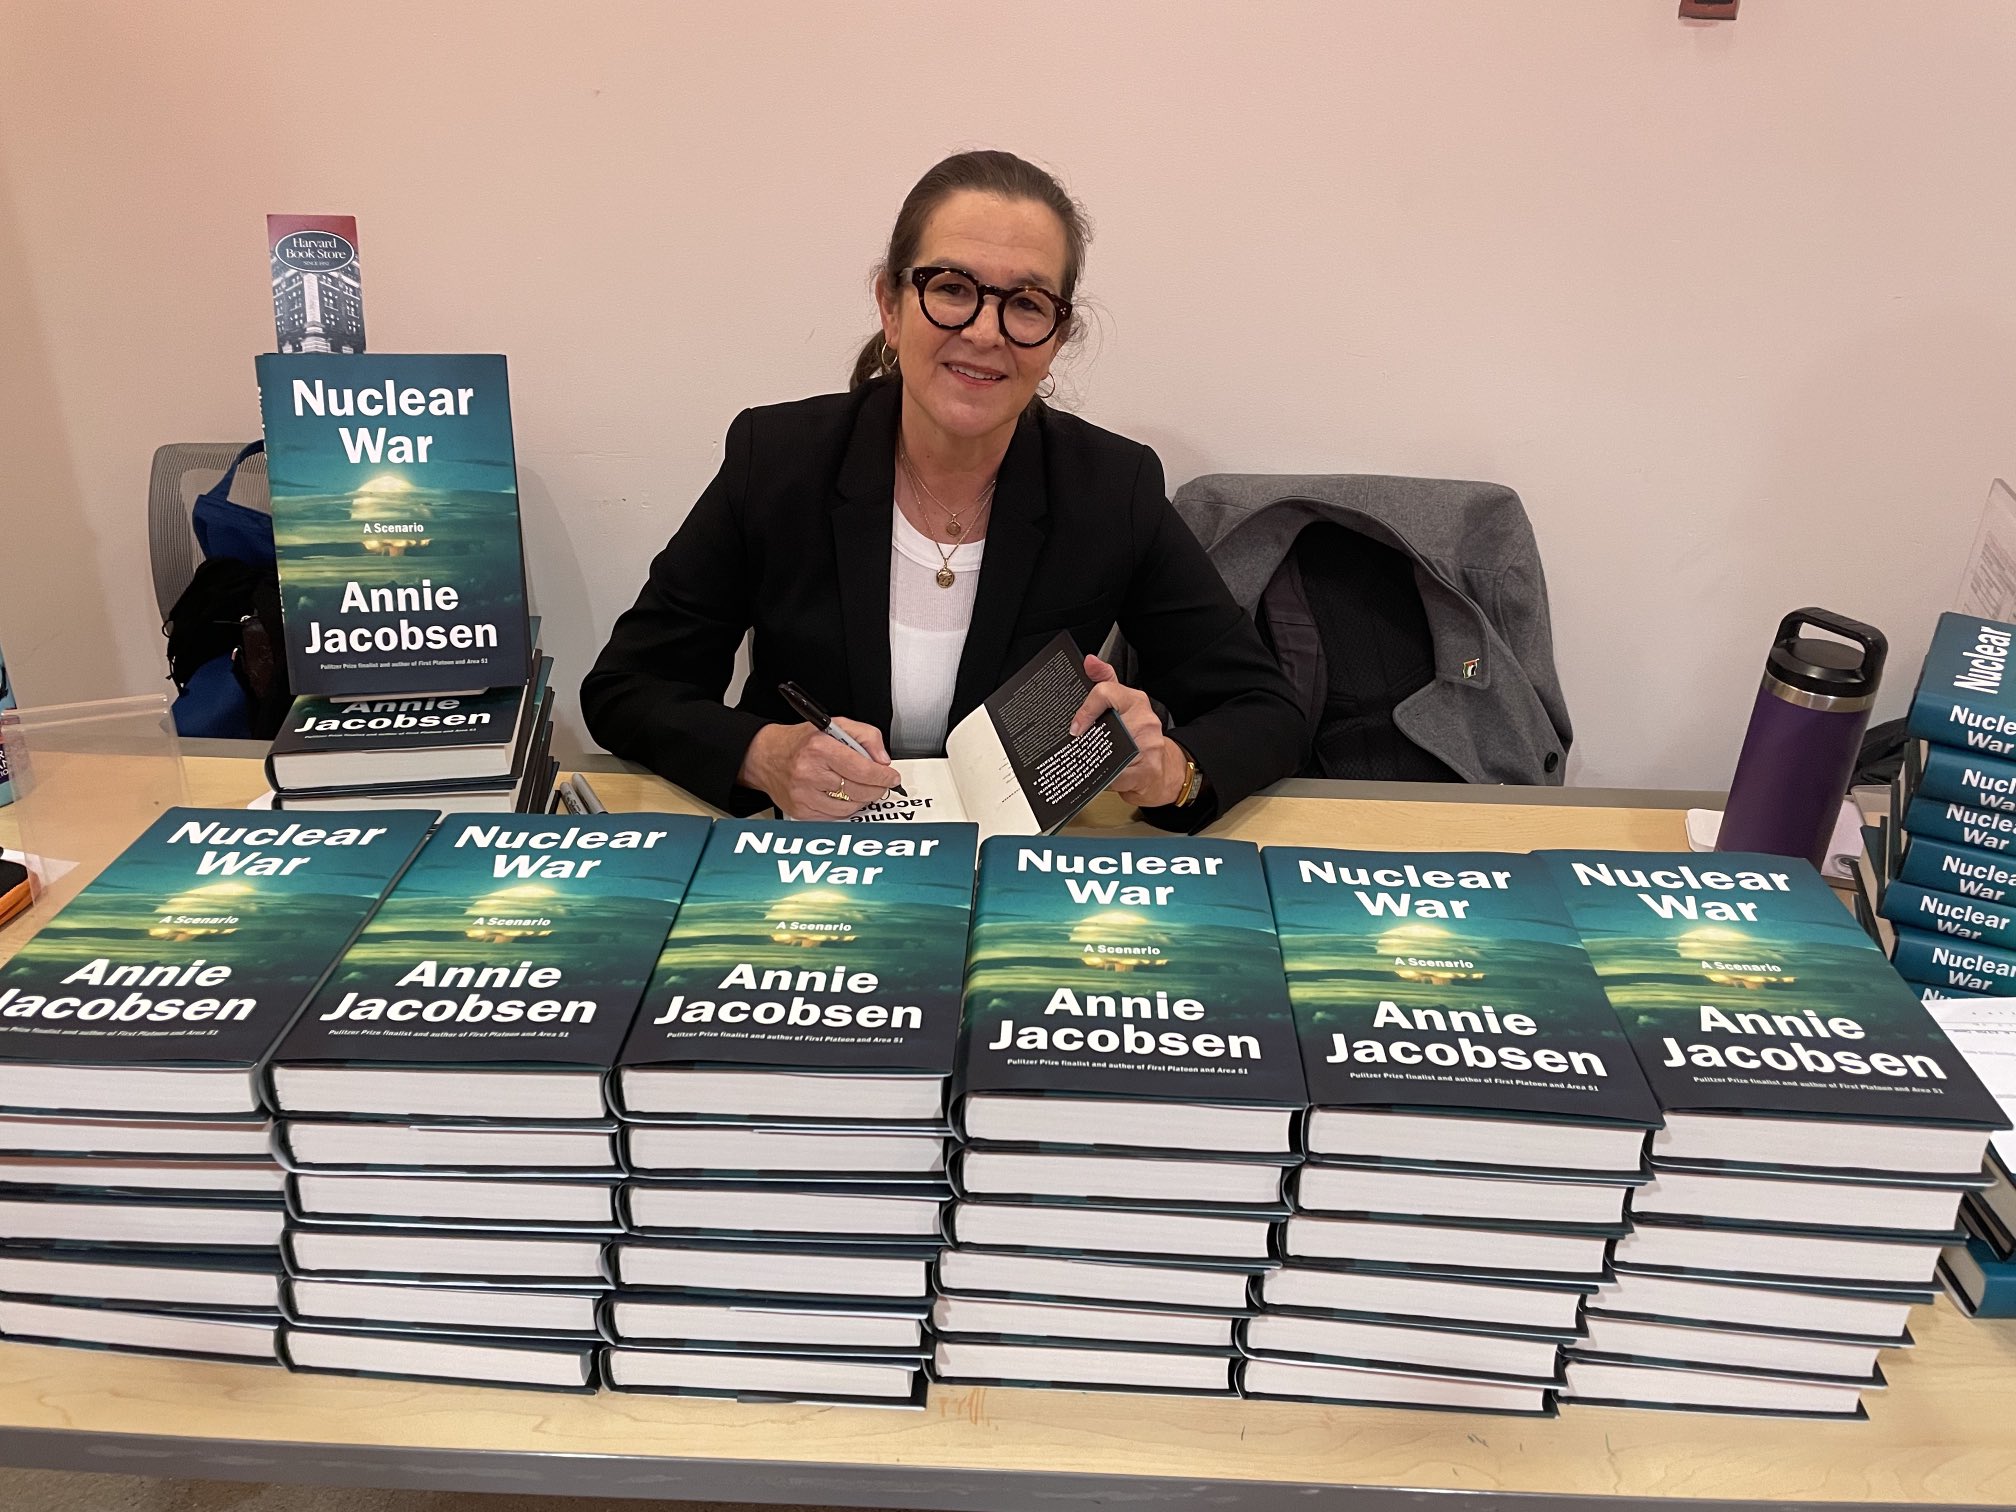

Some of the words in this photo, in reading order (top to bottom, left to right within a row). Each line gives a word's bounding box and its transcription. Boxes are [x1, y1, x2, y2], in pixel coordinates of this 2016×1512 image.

[285, 248, 315, 259] Book
[317, 249, 347, 259] Store
[293, 238, 336, 248] Harvard
[292, 379, 474, 417] Nuclear
[338, 427, 433, 464] War
[363, 523, 372, 534] A
[374, 522, 424, 534] Scenario
[340, 579, 459, 614] Annie
[305, 619, 498, 654] Jacobsen
[1953, 626, 2011, 694] Nuclear
[342, 698, 460, 713] Annie
[294, 712, 491, 732] Jacobsen
[1967, 730, 2015, 754] War
[1962, 769, 2016, 795] Nucl
[1946, 804, 2016, 834] Nucle
[167, 821, 387, 846] Nuclear
[454, 826, 667, 849] Nuclear
[733, 832, 939, 857] Nuclear
[1963, 827, 2009, 850] War
[195, 851, 310, 876] War
[492, 855, 601, 878] War
[777, 860, 883, 885] War
[1017, 849, 1223, 875] Nuclear
[1299, 860, 1512, 890] Nuclear
[1572, 863, 1790, 892] Nuclear
[1065, 879, 1174, 905] War
[1960, 879, 2005, 901] War
[1354, 891, 1470, 919] War
[1638, 894, 1757, 922] War
[1920, 895, 2010, 930] Nuclear
[159, 915, 171, 924] A
[173, 915, 239, 924] Scenario
[473, 917, 484, 926] A
[487, 917, 551, 927] Scenario
[776, 921, 786, 930] A
[790, 921, 851, 932] Scenario
[1937, 919, 1982, 940] War
[1084, 944, 1094, 953] A
[1097, 944, 1160, 955] Scenario
[61, 959, 232, 987] Annie
[395, 961, 562, 988] Annie
[1395, 957, 1404, 966] A
[1407, 958, 1474, 969] Scenario
[1701, 961, 1710, 970] A
[1713, 961, 1782, 973] Scenario
[717, 964, 879, 994] Annie
[1948, 970, 1993, 990] War
[320, 993, 597, 1024] Jacobsen
[653, 996, 922, 1029] Jacobsen
[1044, 988, 1205, 1021] Annie
[1373, 1000, 1538, 1036] Annie
[1700, 1005, 1866, 1040] Annie
[383, 1029, 413, 1037] finalist
[537, 1030, 557, 1038] Area
[720, 1031, 749, 1039] finalist
[795, 1034, 804, 1042] of
[893, 1036, 904, 1044] 51
[989, 1020, 1262, 1059] Jacobsen
[1040, 1058, 1060, 1066] Prize
[1061, 1059, 1090, 1068] finalist
[1109, 1062, 1135, 1070] author
[1137, 1063, 1146, 1071] of
[1147, 1063, 1167, 1072] First
[1200, 1066, 1216, 1074] and
[1217, 1066, 1237, 1074] Area
[1238, 1067, 1249, 1075] 51
[1326, 1033, 1608, 1077] Jacobsen
[1663, 1038, 1948, 1080] Jacobsen
[1384, 1072, 1405, 1080] Prize
[1406, 1073, 1437, 1081] finalist
[1495, 1077, 1515, 1086] First
[1567, 1083, 1588, 1091] Area
[1588, 1084, 1600, 1092] 51
[1728, 1076, 1750, 1084] Prize
[1750, 1077, 1781, 1086] finalist
[1800, 1081, 1828, 1089] author
[1839, 1082, 1859, 1090] First
[1912, 1086, 1932, 1094] Area
[1933, 1087, 1945, 1095] 51
